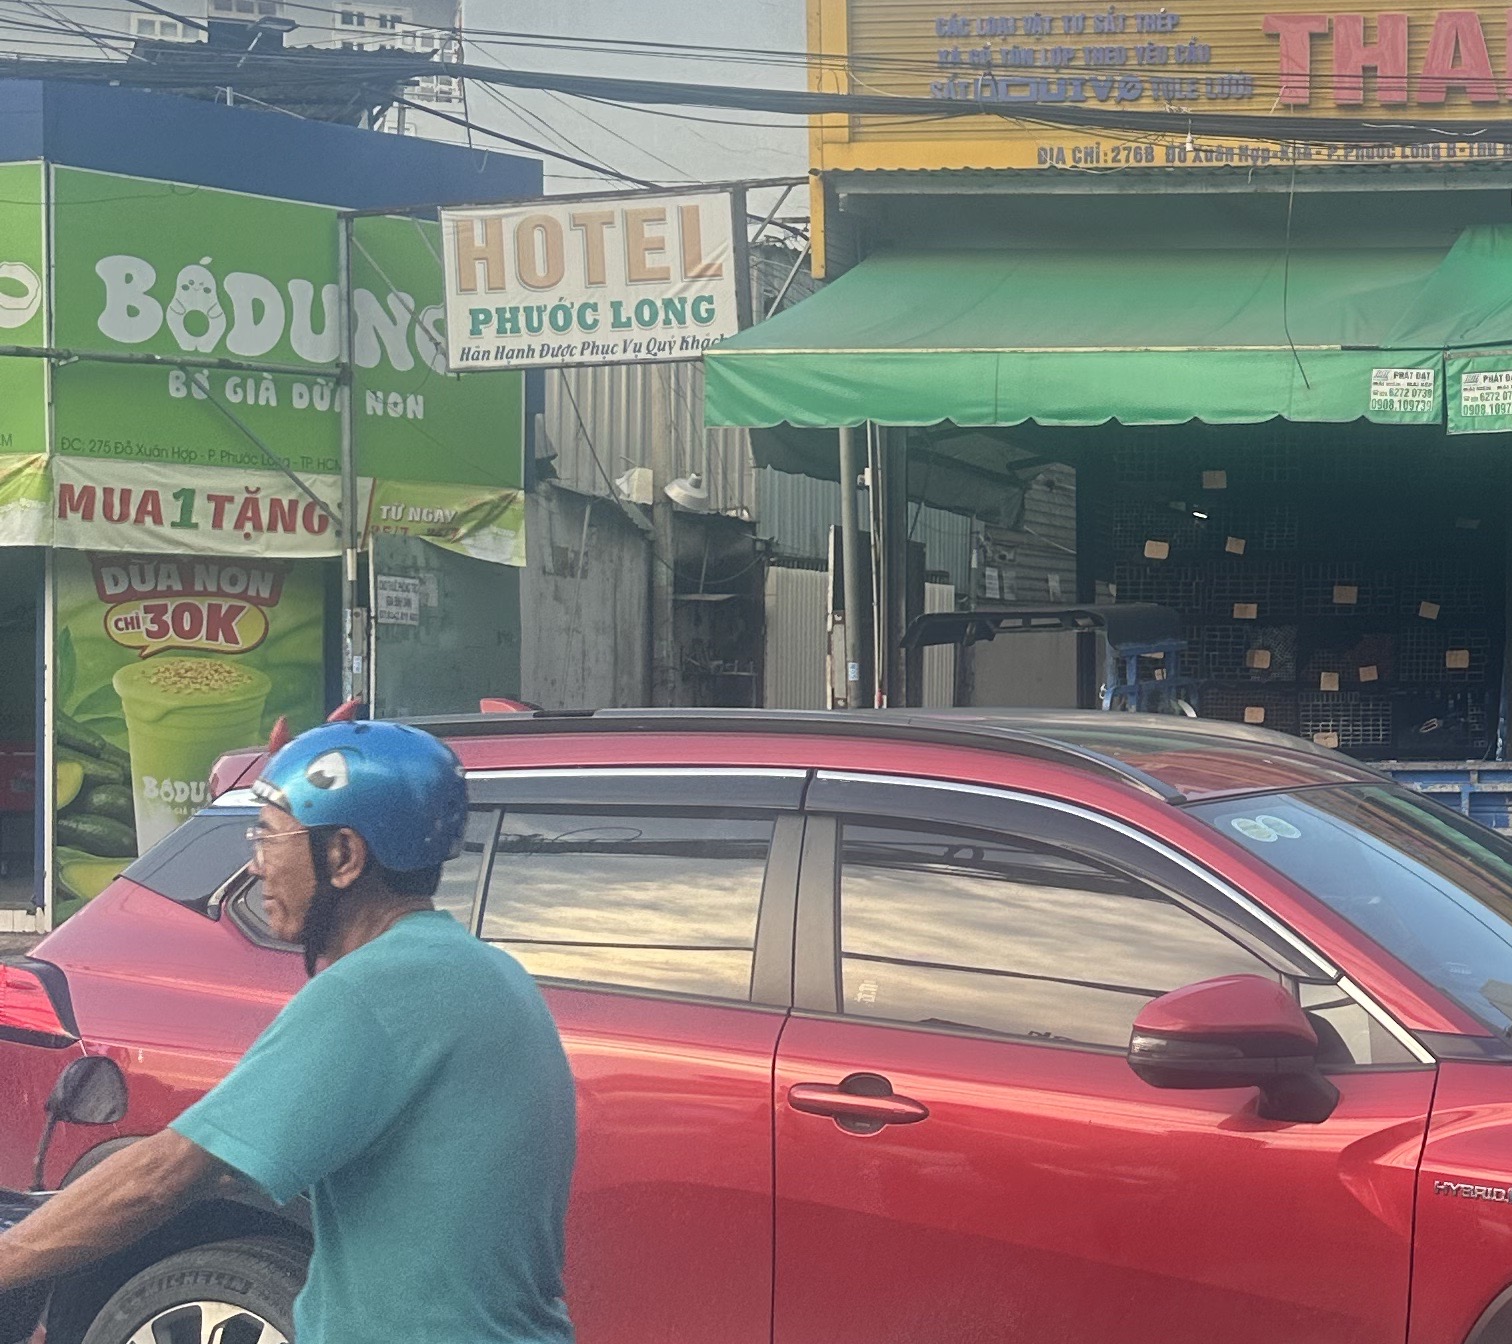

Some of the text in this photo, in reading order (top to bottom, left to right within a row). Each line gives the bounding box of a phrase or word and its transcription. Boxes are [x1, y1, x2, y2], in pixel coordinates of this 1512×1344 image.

[935, 13, 970, 37] CÁC
[1093, 5, 1127, 35] SẮT
[1135, 7, 1181, 34] THÉP
[1083, 45, 1128, 66] THEO
[456, 205, 724, 295] HOTEL
[469, 295, 716, 338] PHƯỚC LONG
[460, 346, 492, 363] Hân
[494, 344, 535, 365] Hạnh
[539, 344, 577, 364] Được
[580, 339, 618, 360] Phục
[622, 338, 643, 359] Vụ
[645, 335, 676, 357] Quý
[225, 372, 278, 407] GIÀ
[365, 389, 424, 420] NON
[1389, 387, 1410, 399] 6272
[1411, 387, 1433, 399] 0739
[1479, 391, 1501, 403] 6272
[89, 440, 111, 455] 275
[136, 444, 169, 458] Xuân
[57, 483, 331, 540] MUA 1 TẶNG
[194, 562, 275, 599] NON
[113, 602, 247, 646] CHỈ 30K
[1434, 1180, 1508, 1203] HYBRID
